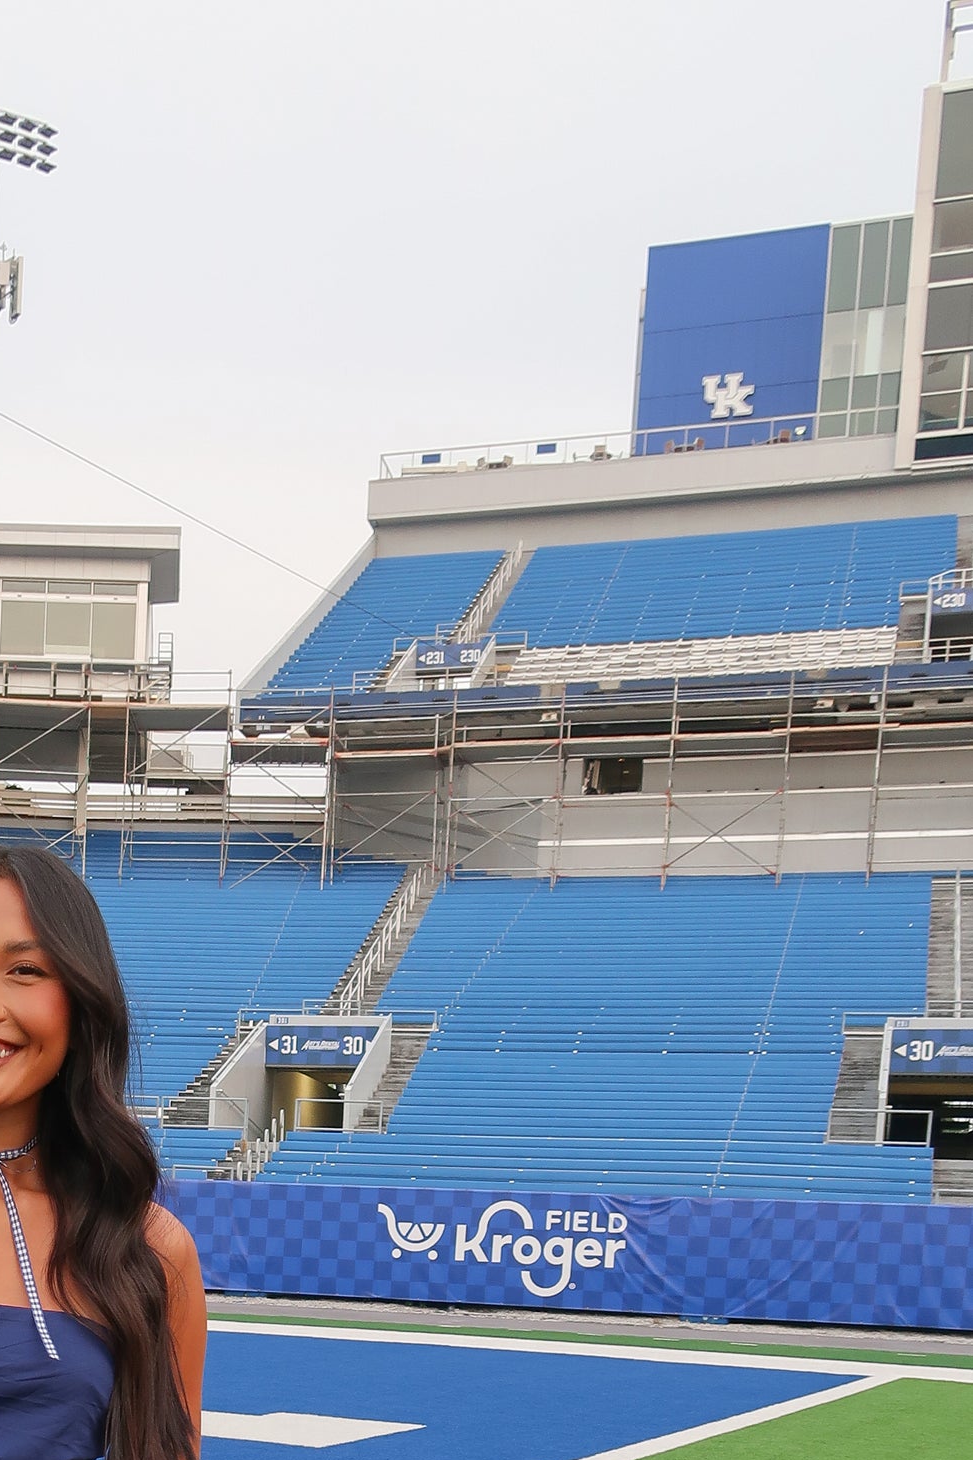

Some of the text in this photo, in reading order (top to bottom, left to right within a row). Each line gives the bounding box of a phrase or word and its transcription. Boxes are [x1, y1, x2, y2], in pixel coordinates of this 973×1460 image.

[426, 649, 481, 665] 231 230
[281, 1035, 298, 1054] 31
[342, 1036, 364, 1055] 30
[908, 1040, 934, 1061] 30
[545, 1210, 628, 1234] FIELD
[454, 1200, 626, 1297] Kroger
